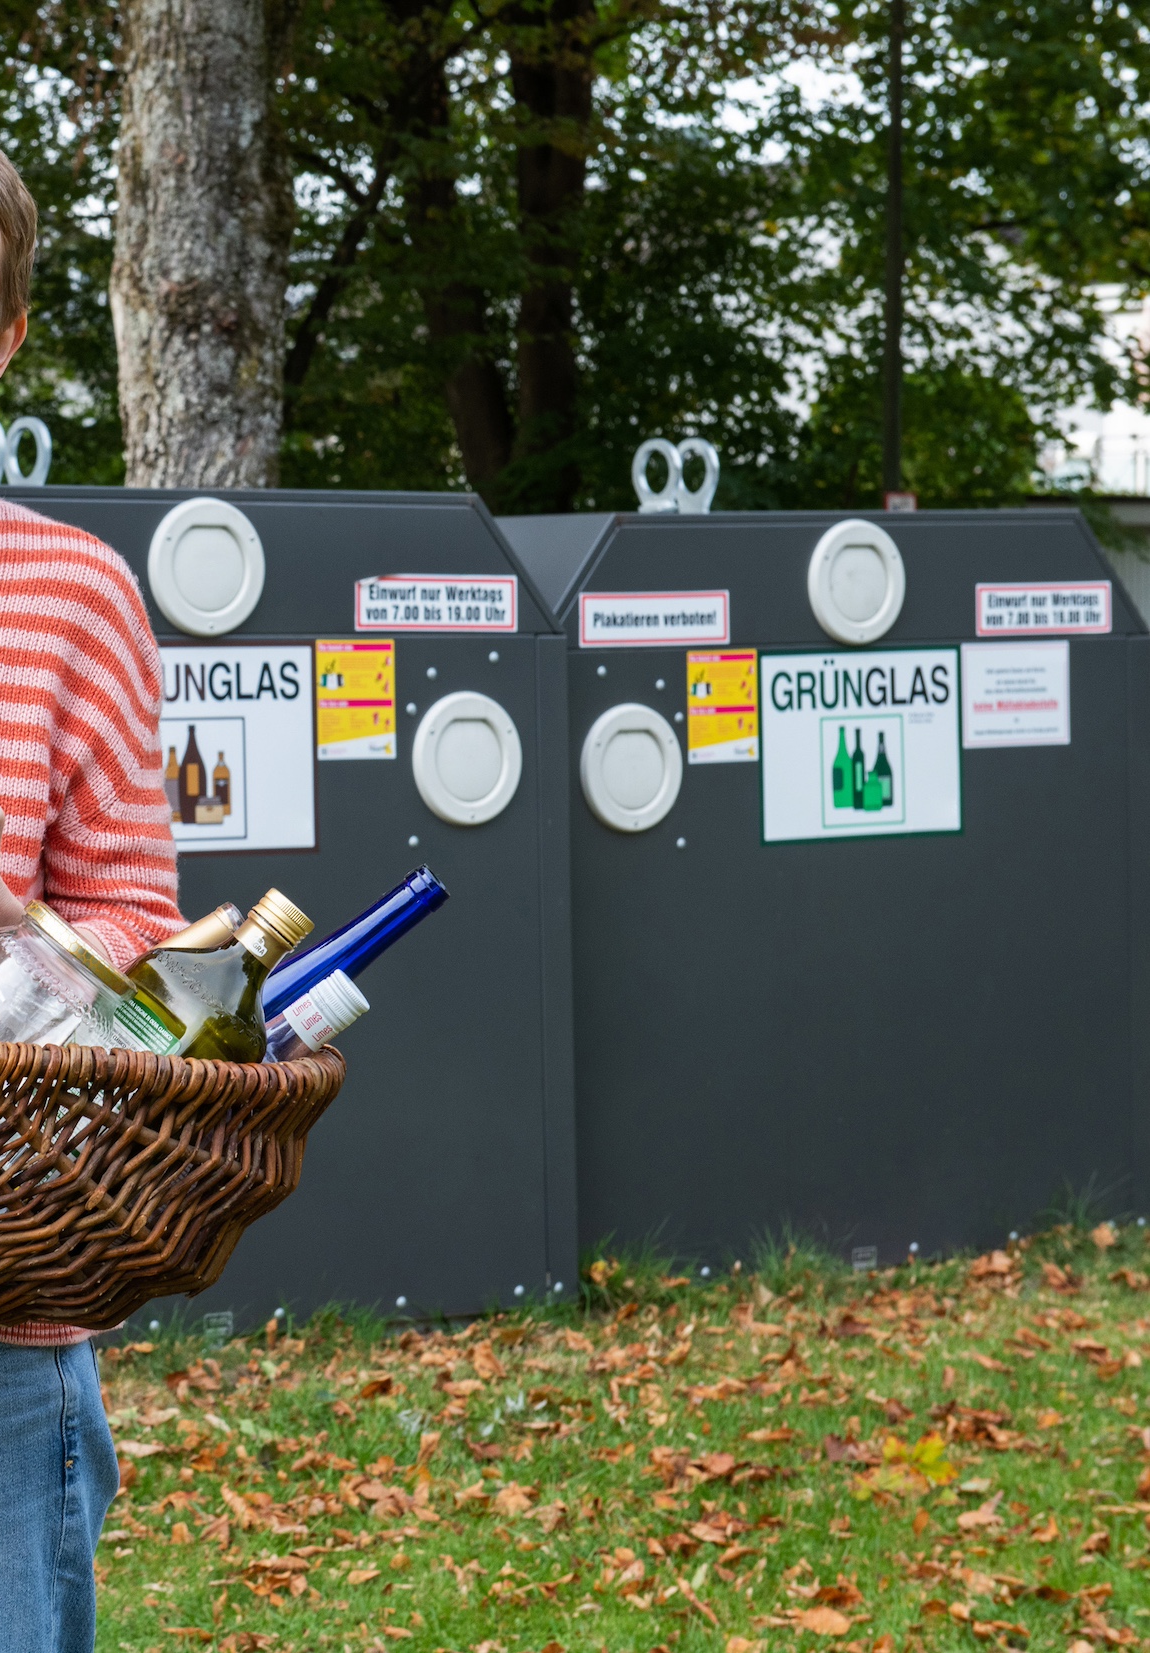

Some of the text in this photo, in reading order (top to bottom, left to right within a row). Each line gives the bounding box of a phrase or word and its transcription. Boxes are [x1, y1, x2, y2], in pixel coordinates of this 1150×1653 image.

[368, 584, 503, 603] Einwurf nur Werktags
[365, 605, 506, 622] von 7.00 bis 19.00 Uhr
[592, 610, 717, 629] Plakatieren verboten!
[162, 661, 300, 704] UNGLAS
[770, 658, 950, 712] GRÜNGLAS
[292, 999, 312, 1017] Limes
[301, 1011, 323, 1031] Limes
[311, 1024, 334, 1043] Limes
